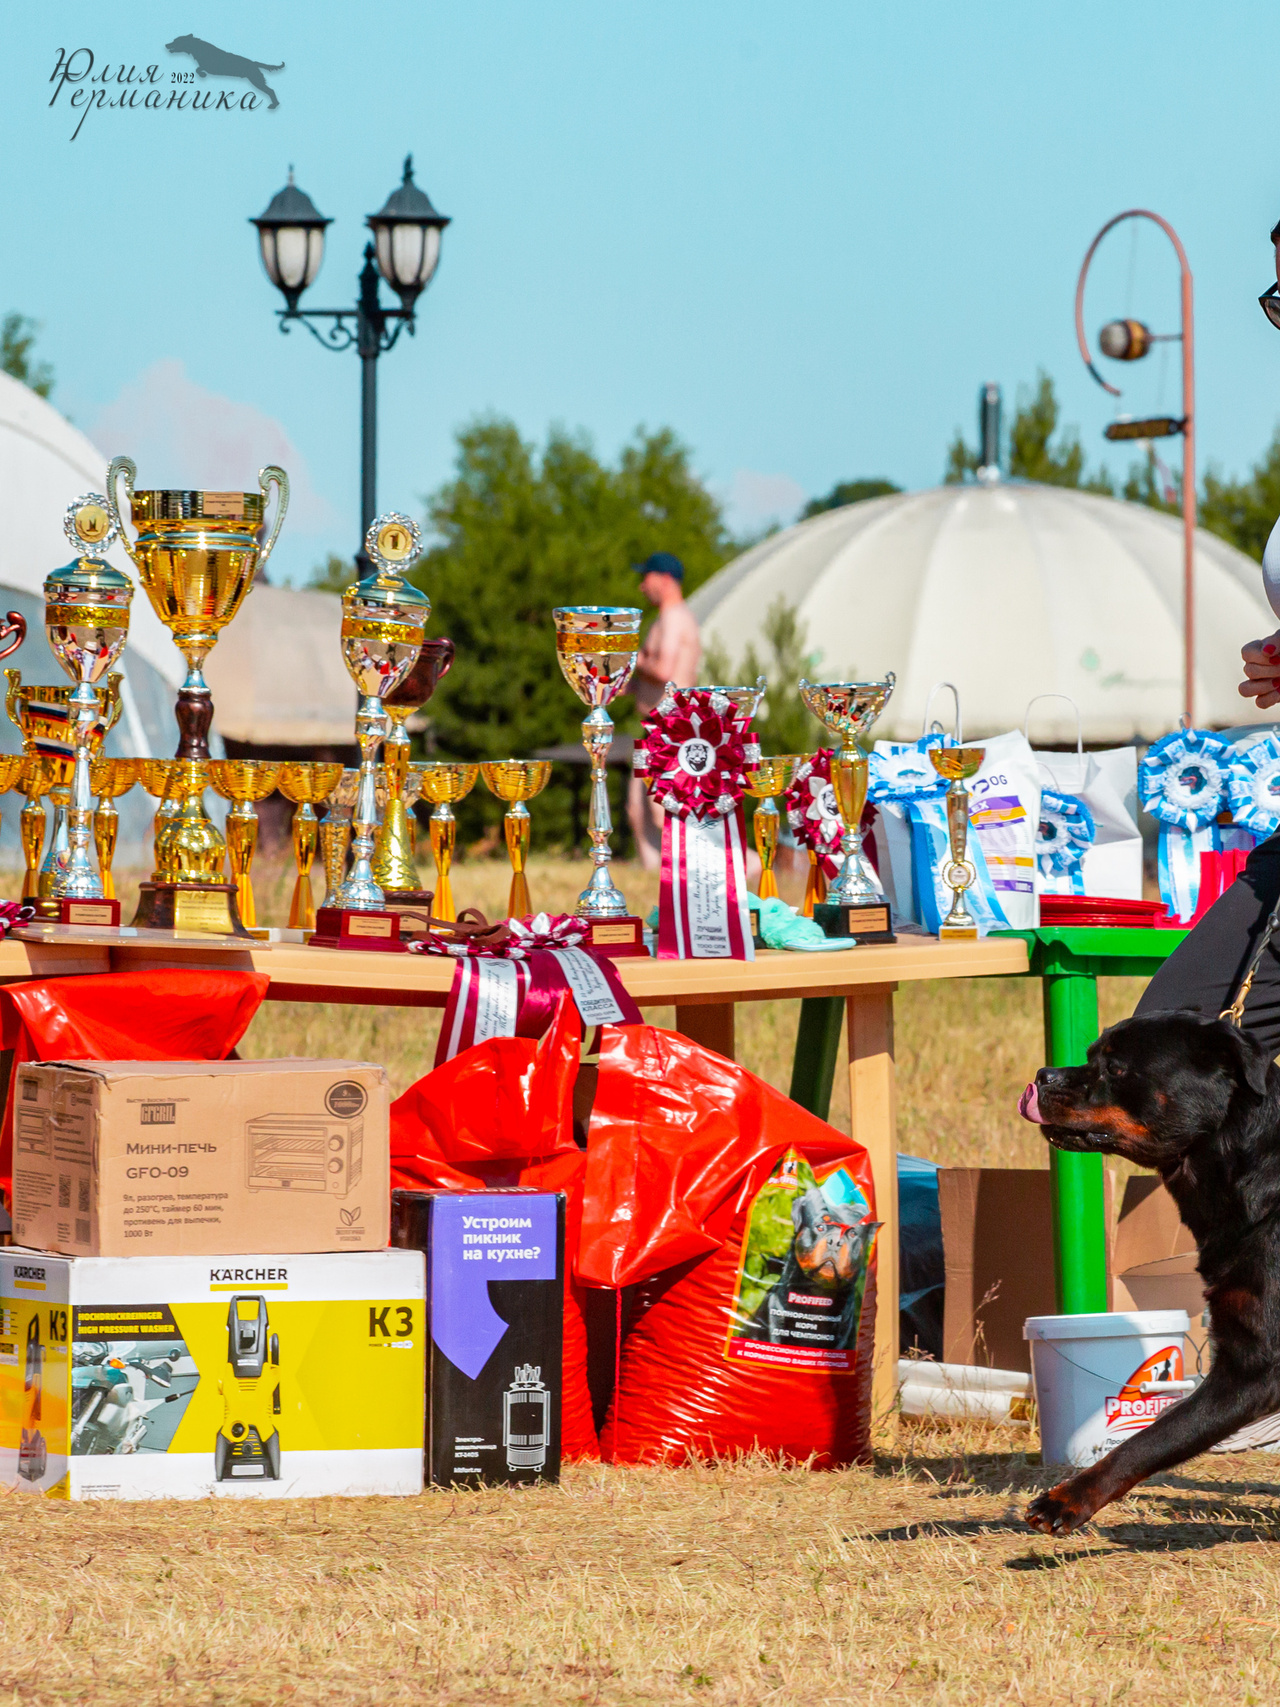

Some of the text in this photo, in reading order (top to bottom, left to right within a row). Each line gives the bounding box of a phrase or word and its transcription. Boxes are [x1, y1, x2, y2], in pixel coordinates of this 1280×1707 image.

[126, 1166, 189, 1179] GFO-09
[177, 1192, 229, 1201] температура
[123, 1206, 134, 1215] до
[193, 1204, 203, 1212] 60
[462, 1215, 532, 1231] Устроим
[124, 1230, 143, 1238] 1000
[463, 1233, 522, 1244] пикник
[463, 1246, 541, 1263] на кухне?
[210, 1268, 288, 1281] KÄRCHER
[788, 1292, 833, 1306] PROFIFEED
[78, 1311, 163, 1321] HOCHDRUCKREINIGER
[78, 1324, 175, 1335] HIGH PRESSURE WASHER
[795, 1322, 817, 1330] КОРМ
